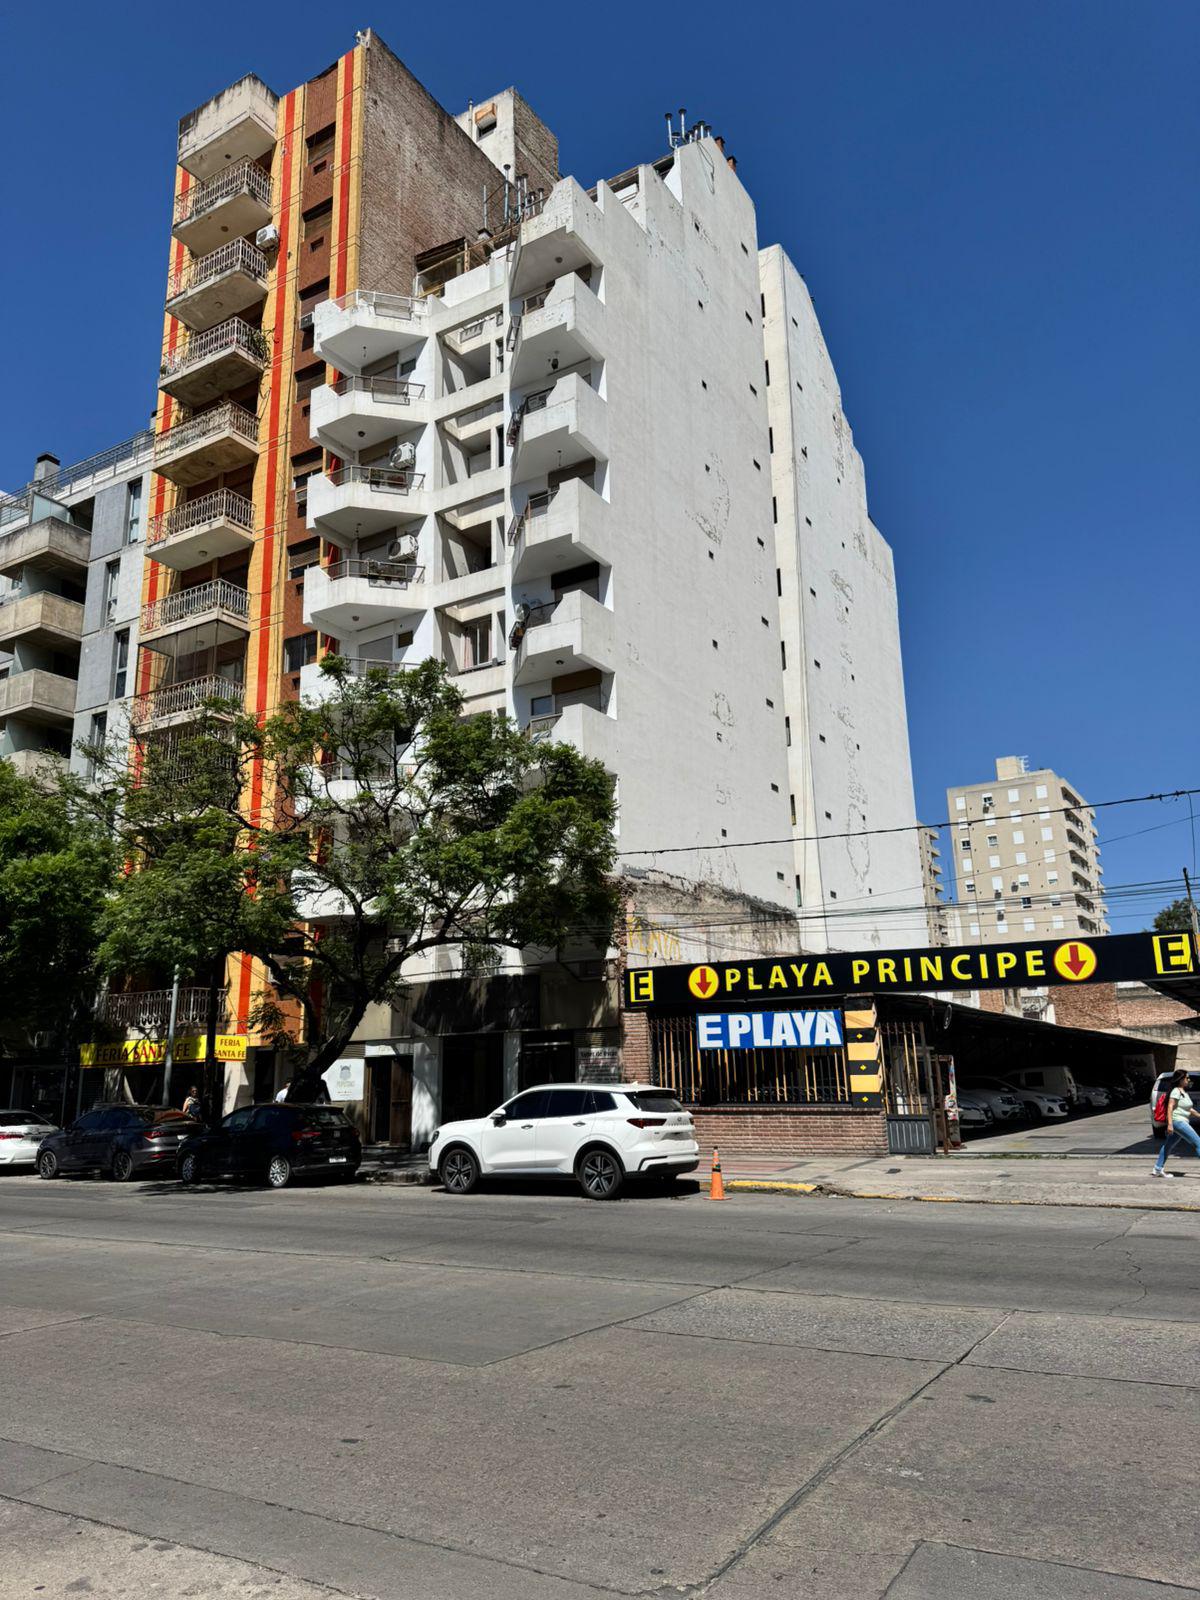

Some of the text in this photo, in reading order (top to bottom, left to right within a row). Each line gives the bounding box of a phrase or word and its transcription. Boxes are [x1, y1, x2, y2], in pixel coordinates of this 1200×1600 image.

[725, 949, 1047, 992] PLAYA PRINCIPE
[634, 971, 651, 1000] E
[728, 1011, 842, 1047] PLAYA
[97, 1046, 129, 1061] FERIA
[175, 1042, 191, 1057] FE
[213, 1049, 246, 1058] SANTA FE
[220, 1038, 241, 1047] FERIA
